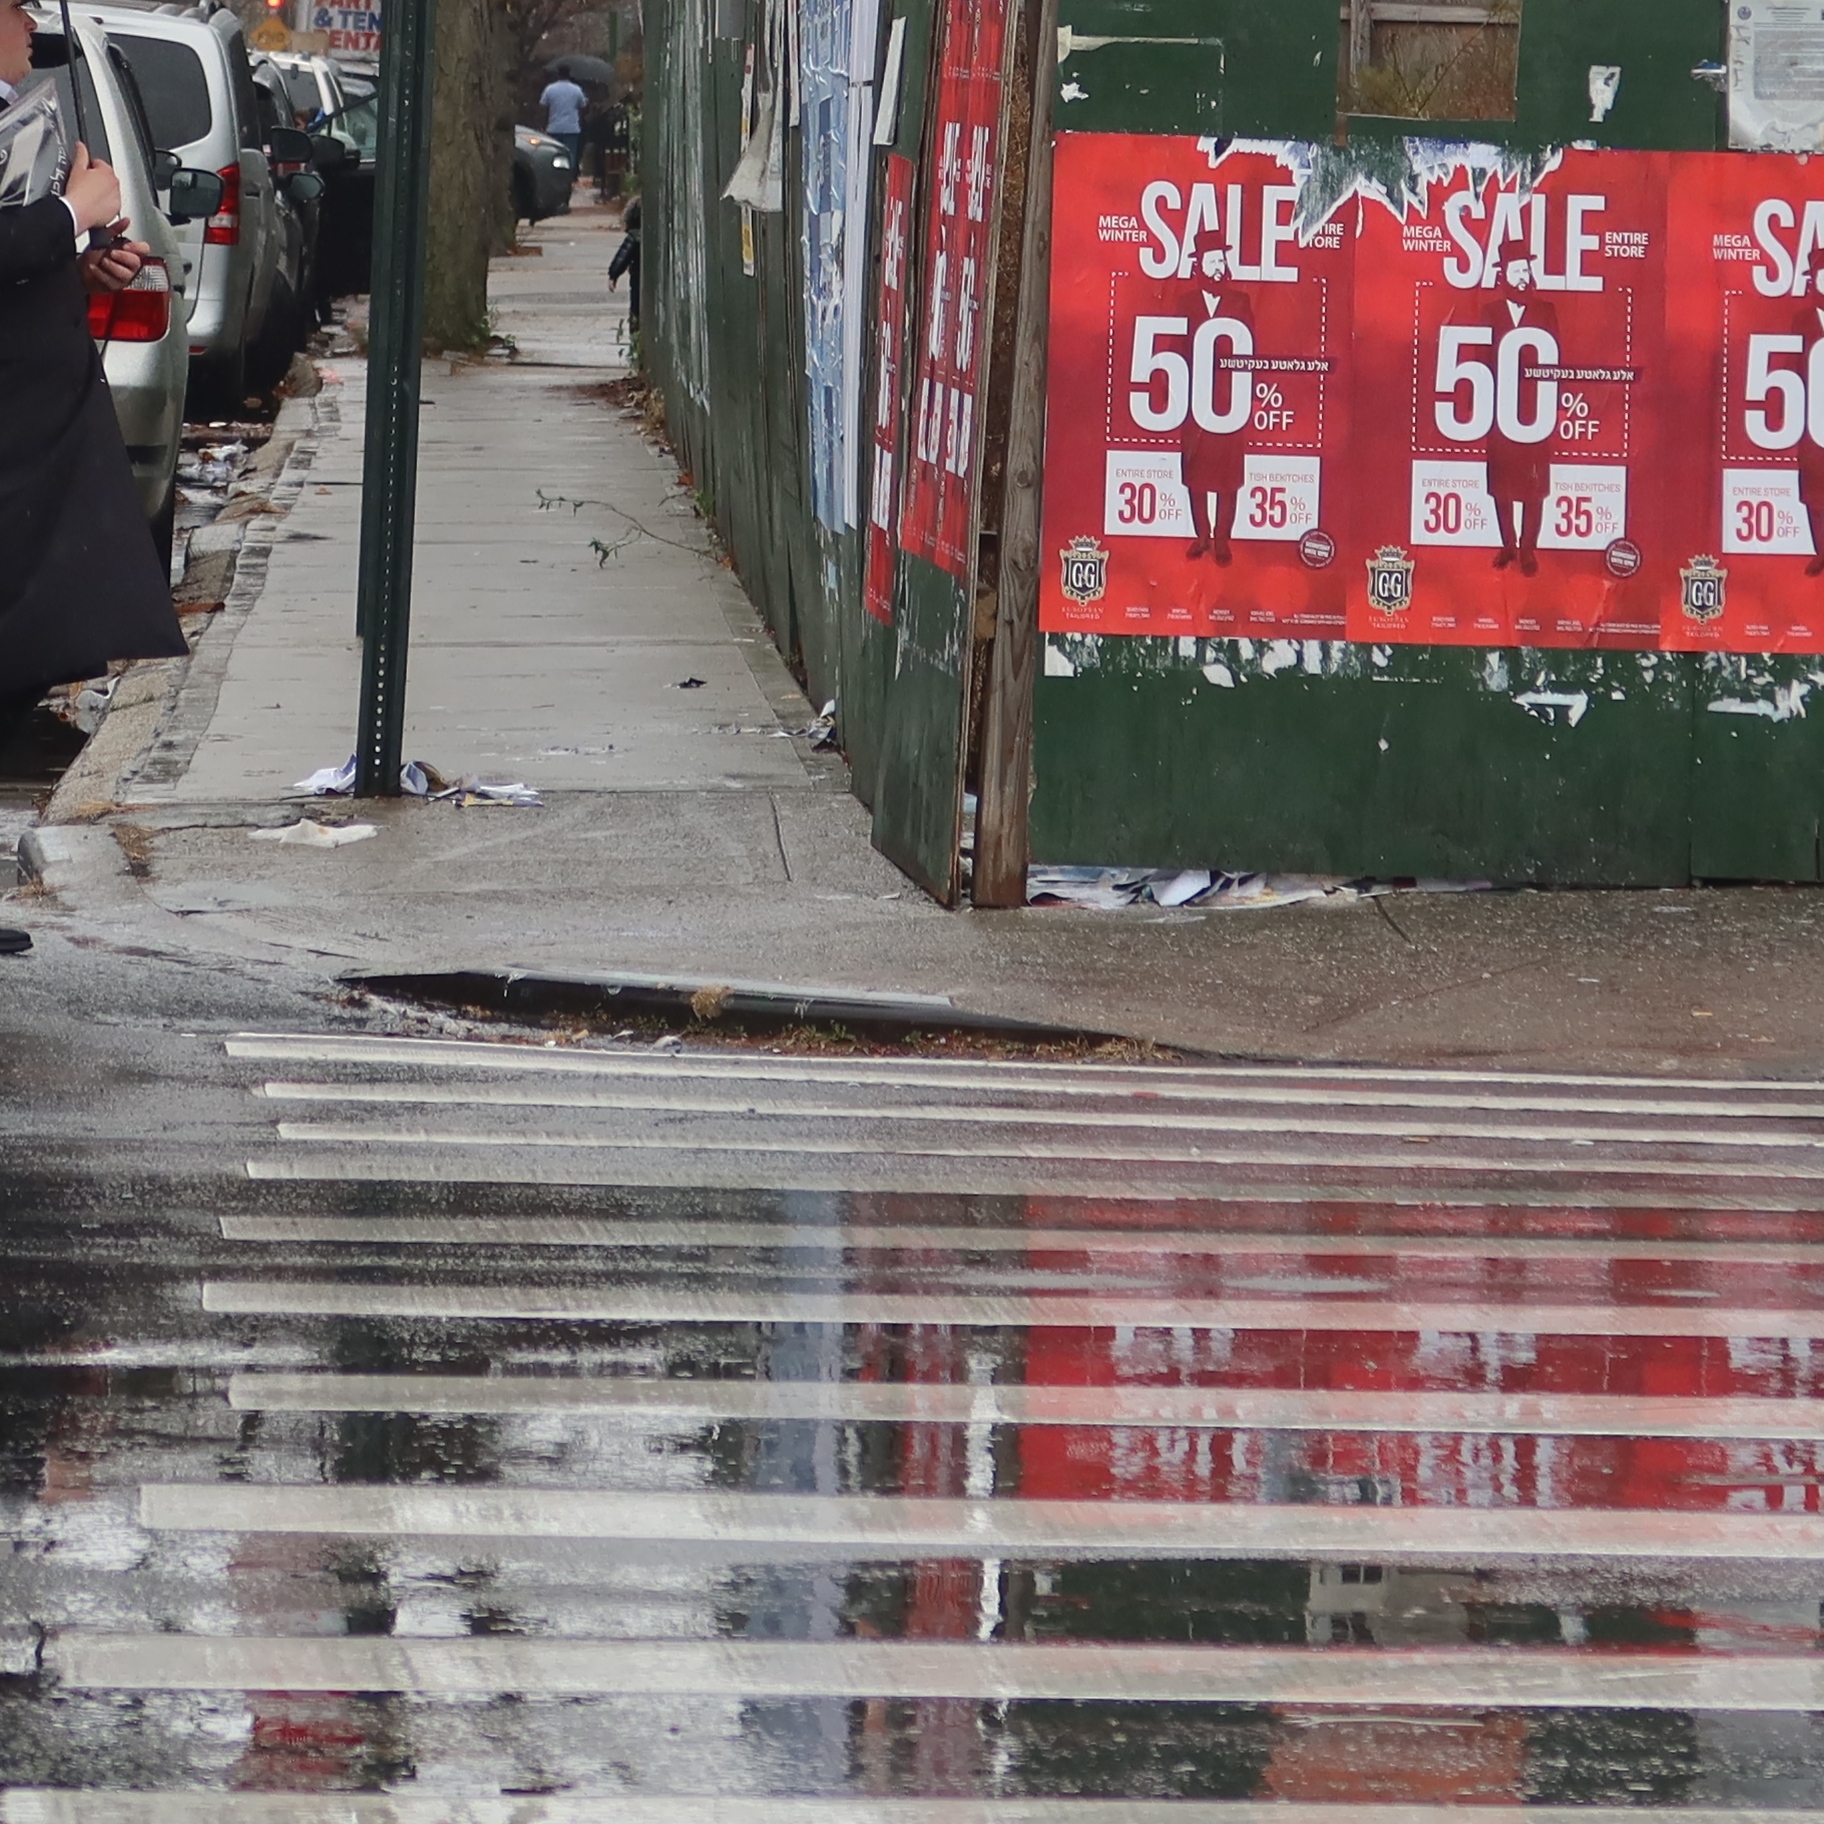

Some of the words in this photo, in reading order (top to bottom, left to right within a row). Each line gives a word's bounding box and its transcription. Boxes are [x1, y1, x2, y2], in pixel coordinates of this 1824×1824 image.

[313, 8, 334, 28] &
[337, 10, 383, 32] TEN
[1099, 215, 1139, 230] MEGA
[1139, 180, 1299, 283] SALE
[1404, 225, 1444, 240] MEGA
[1099, 228, 1148, 244] WINTER
[1404, 238, 1453, 254] WINTER
[1444, 190, 1604, 293] SALE
[1605, 231, 1649, 246] ENTIRE
[1713, 233, 1753, 248] MEGA
[1604, 243, 1645, 259] STORE
[1713, 246, 1762, 262] WINTER
[1128, 315, 1255, 435] 50
[1433, 325, 1560, 445] 50
[1255, 383, 1283, 410] %
[1560, 393, 1588, 420] %
[1254, 410, 1295, 432] OFF
[1559, 420, 1600, 442] OFF
[1117, 482, 1157, 524] 30
[1158, 507, 1183, 521] OFF
[1248, 486, 1288, 529] 35
[1422, 492, 1462, 534] 30
[1289, 511, 1313, 526] OFF
[1553, 496, 1593, 539] 35
[1733, 500, 1773, 542] 30
[1072, 564, 1097, 590] GG
